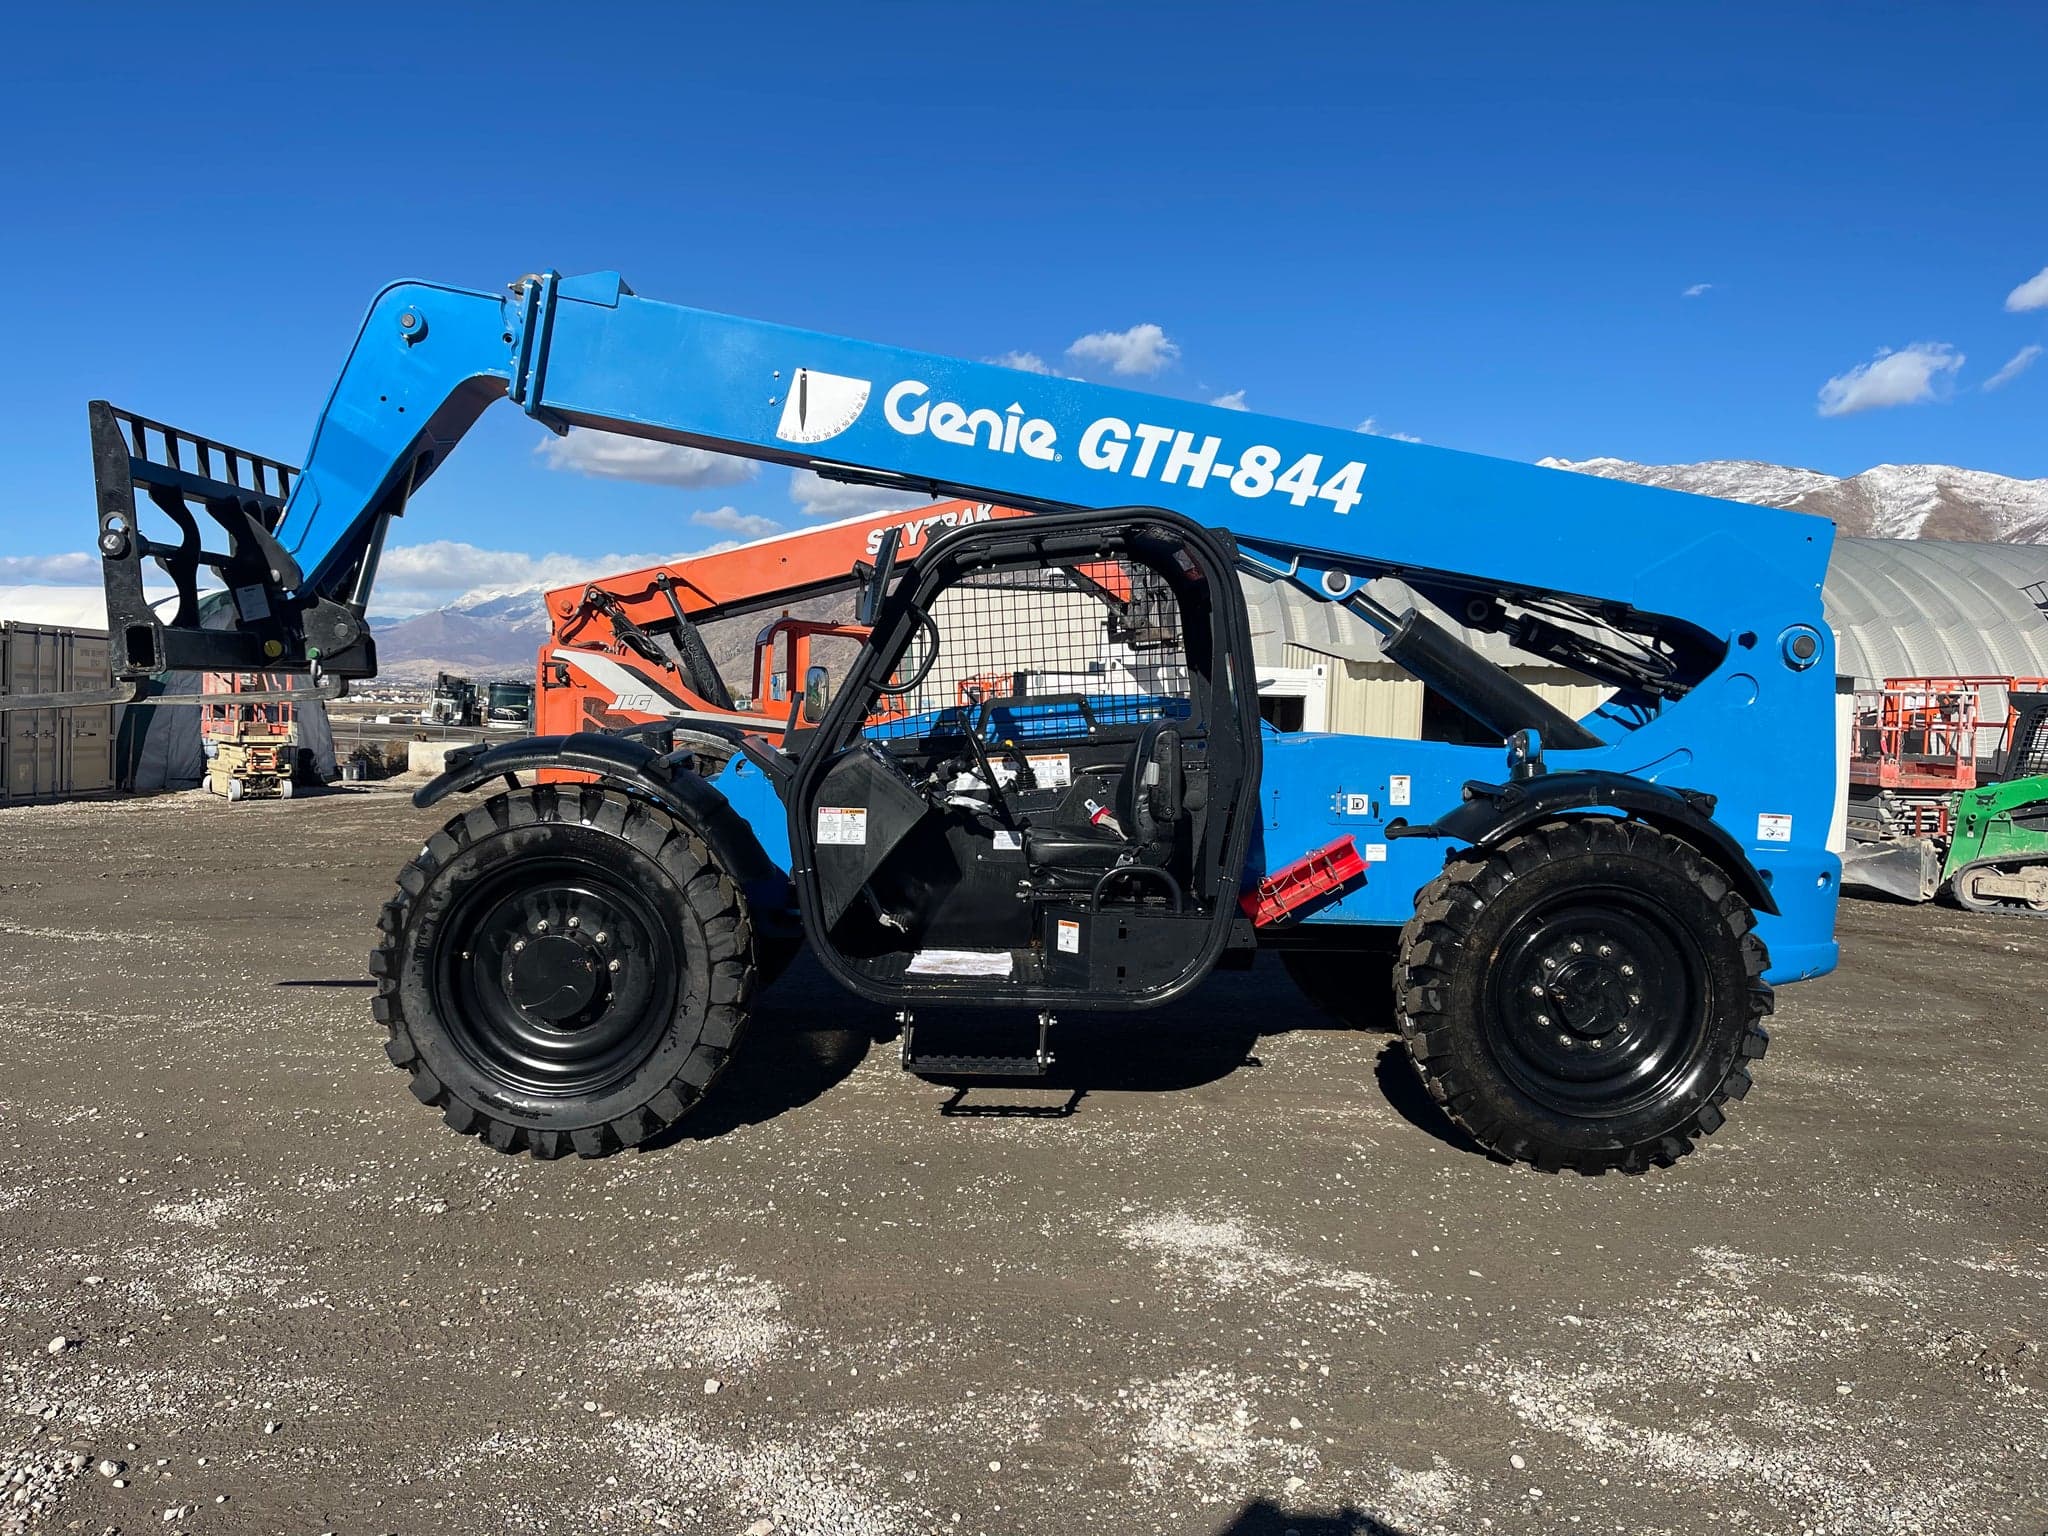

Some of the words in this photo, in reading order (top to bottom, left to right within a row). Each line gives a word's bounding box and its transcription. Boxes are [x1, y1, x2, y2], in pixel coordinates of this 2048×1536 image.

[884, 380, 1057, 461] Genie
[1078, 417, 1367, 515] GTH-844
[865, 503, 993, 555] SYRAK
[607, 694, 652, 711] JLG
